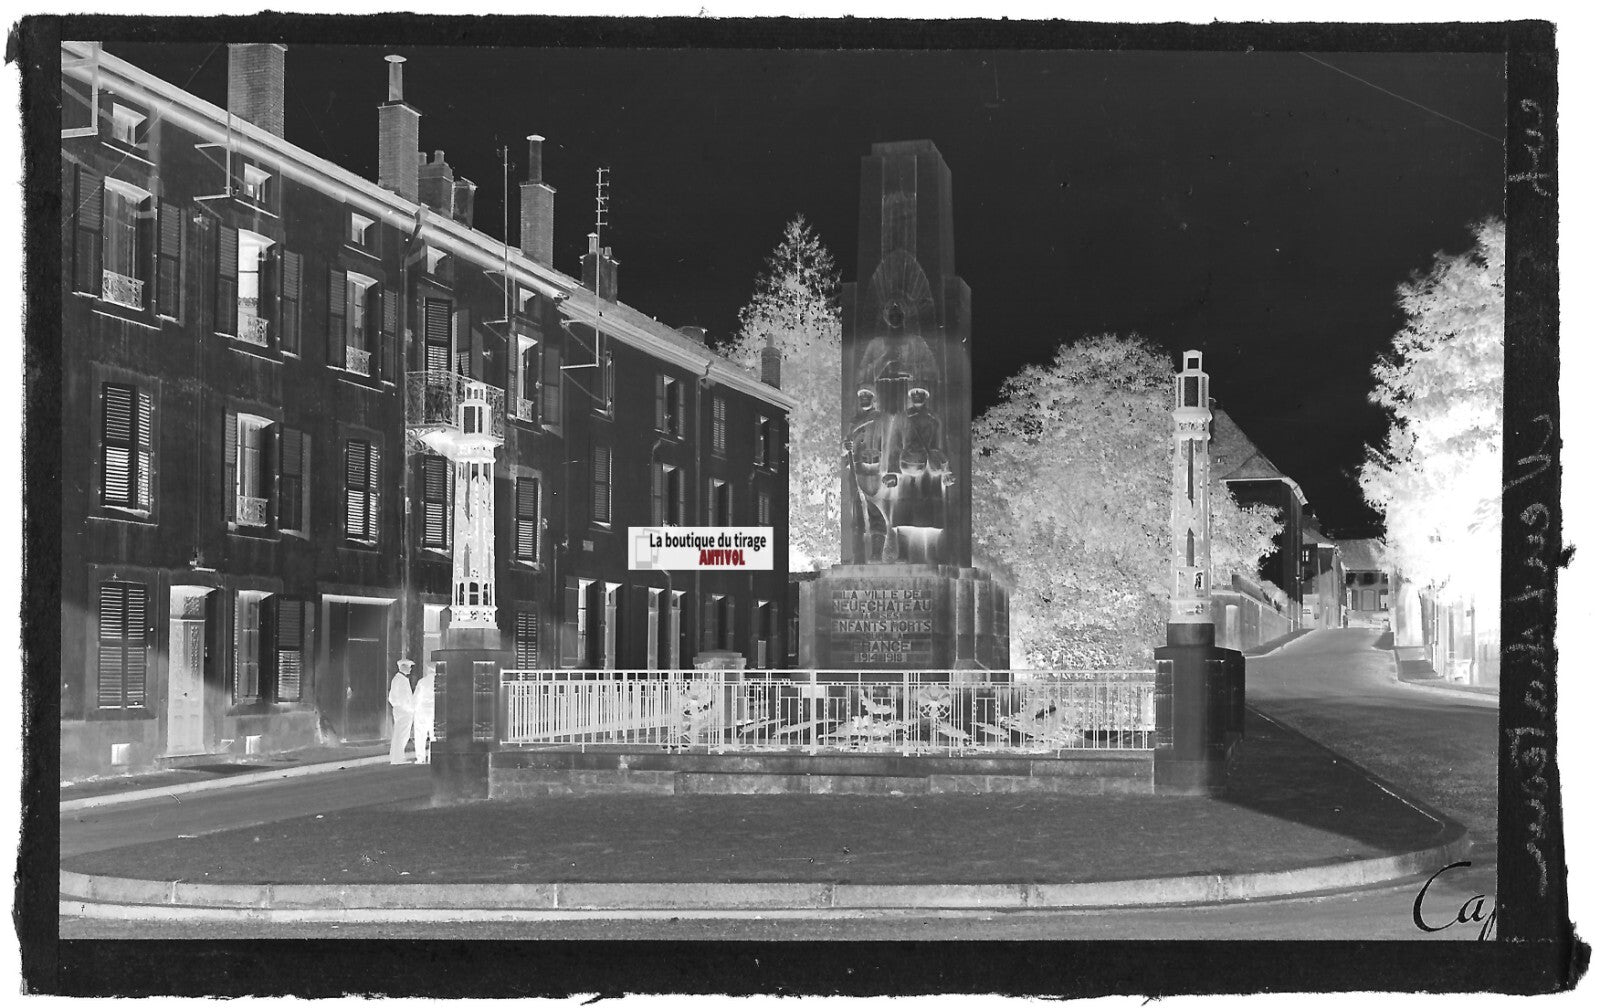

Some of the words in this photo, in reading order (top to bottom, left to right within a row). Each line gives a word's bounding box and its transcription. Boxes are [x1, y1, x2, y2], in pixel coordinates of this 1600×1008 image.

[842, 590, 858, 599] LA
[864, 590, 899, 599] VILLE
[903, 590, 921, 599] DE
[832, 621, 887, 632] ENFANTS
[890, 621, 931, 632] MORTS
[854, 641, 910, 652] FRANCE
